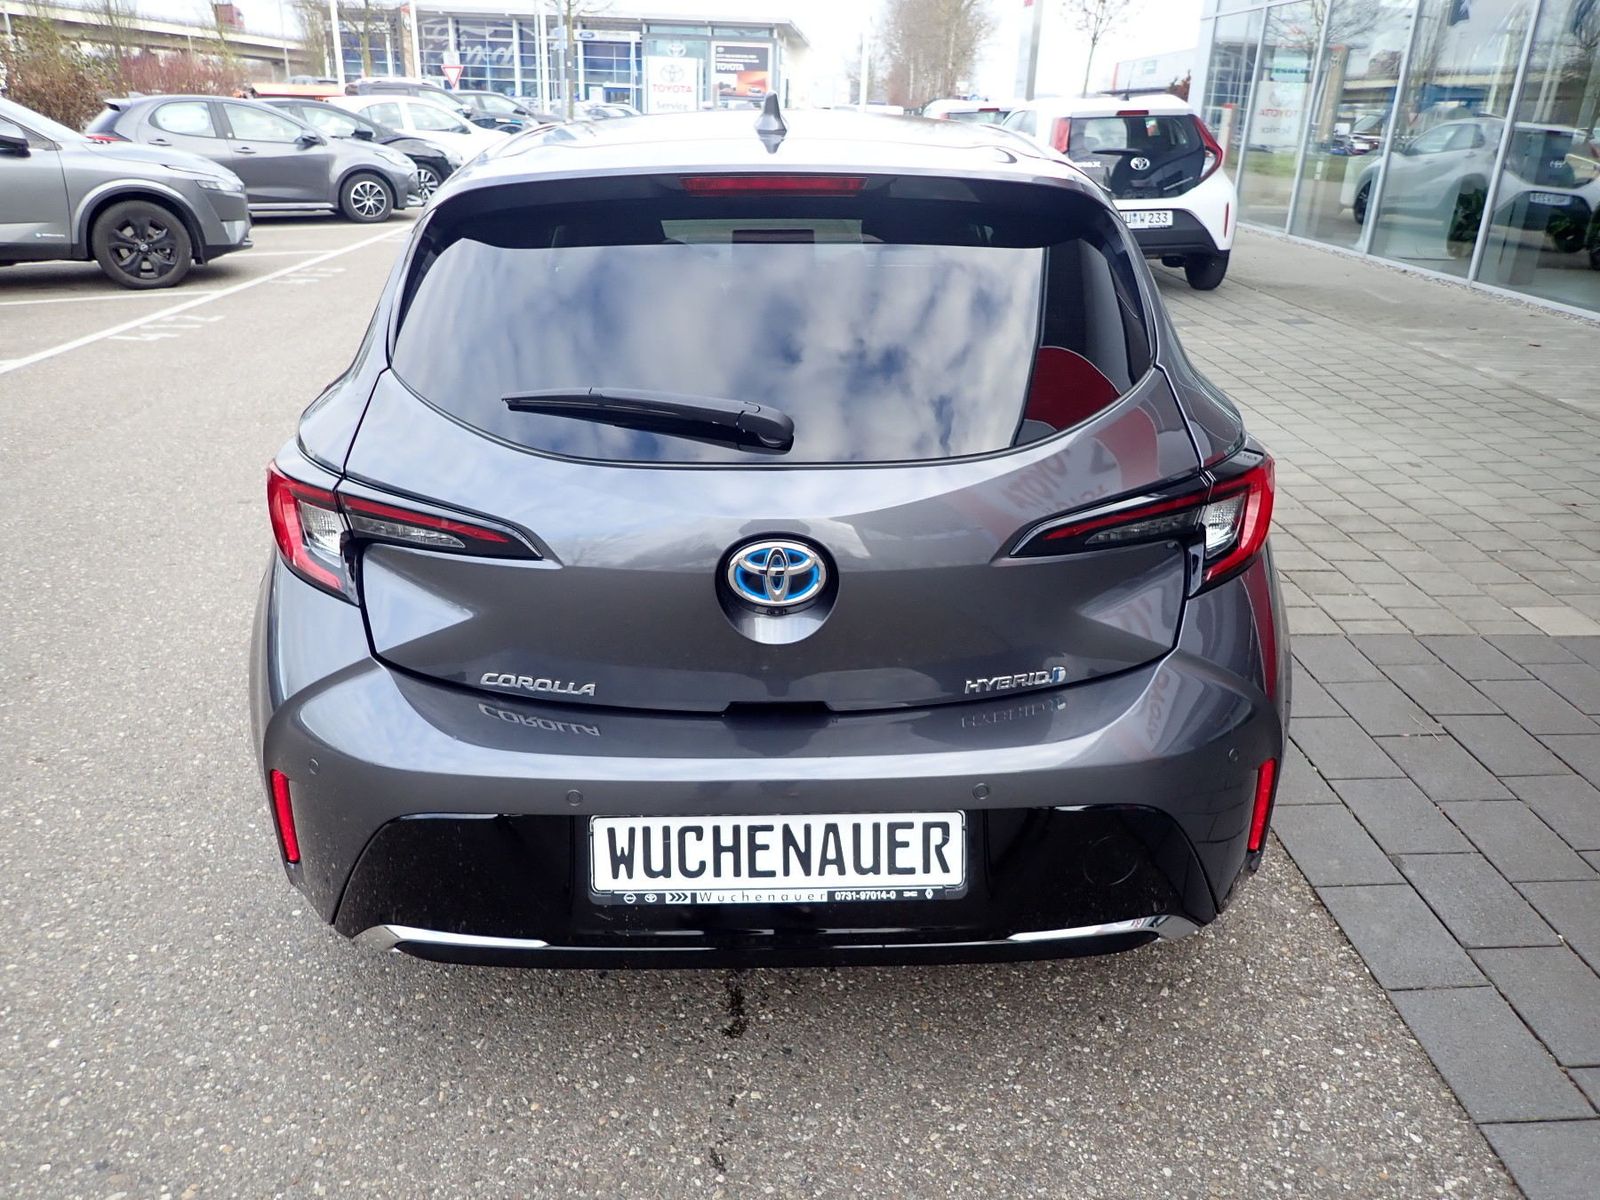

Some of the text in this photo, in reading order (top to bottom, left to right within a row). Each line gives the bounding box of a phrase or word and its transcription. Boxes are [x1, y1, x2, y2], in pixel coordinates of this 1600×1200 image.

[716, 63, 744, 71] TOYOTA
[652, 83, 693, 93] TOYOTA
[656, 101, 689, 110] Service
[1148, 212, 1169, 224] 233
[480, 672, 596, 697] COROLLA
[964, 670, 1051, 694] HYBRID
[606, 820, 951, 880] WUCHENAUER
[699, 889, 897, 903] Wuchenauer 0731-97014-0
